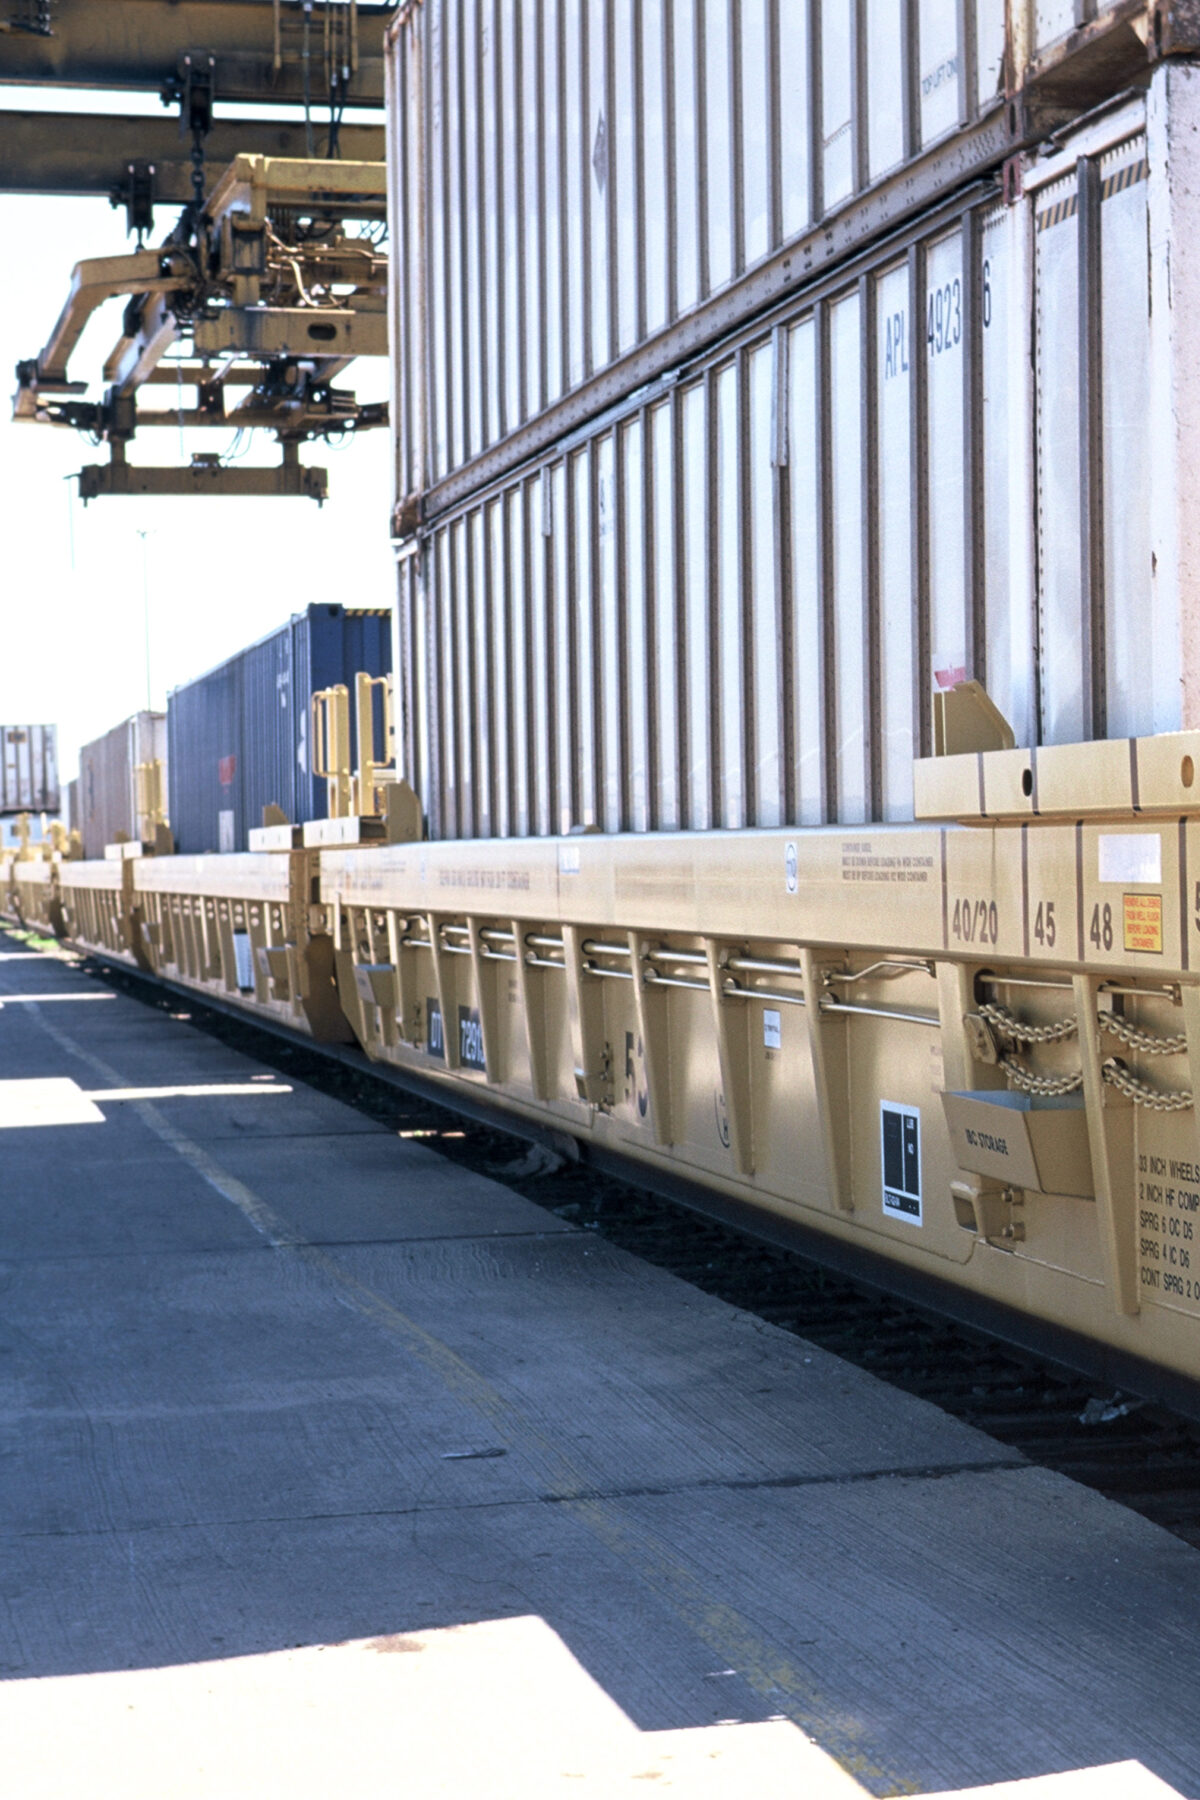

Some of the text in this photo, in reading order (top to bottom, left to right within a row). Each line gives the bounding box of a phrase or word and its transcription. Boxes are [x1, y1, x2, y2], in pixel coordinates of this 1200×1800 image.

[952, 899, 998, 945] 40/20
[1034, 901, 1056, 947] 45
[1090, 903, 1113, 951] 48
[1150, 1156, 1166, 1177] INCH
[1169, 1159, 1200, 1184] WHEELS
[1139, 1183, 1200, 1214] 2 INCH HF COMP
[1139, 1209, 1159, 1232] SPRG
[1169, 1216, 1180, 1238] OC
[1140, 1237, 1160, 1260] SPRG
[1141, 1266, 1160, 1289] CONT
[1163, 1272, 1183, 1296] SPRG
[1186, 1280, 1191, 1298] 2
